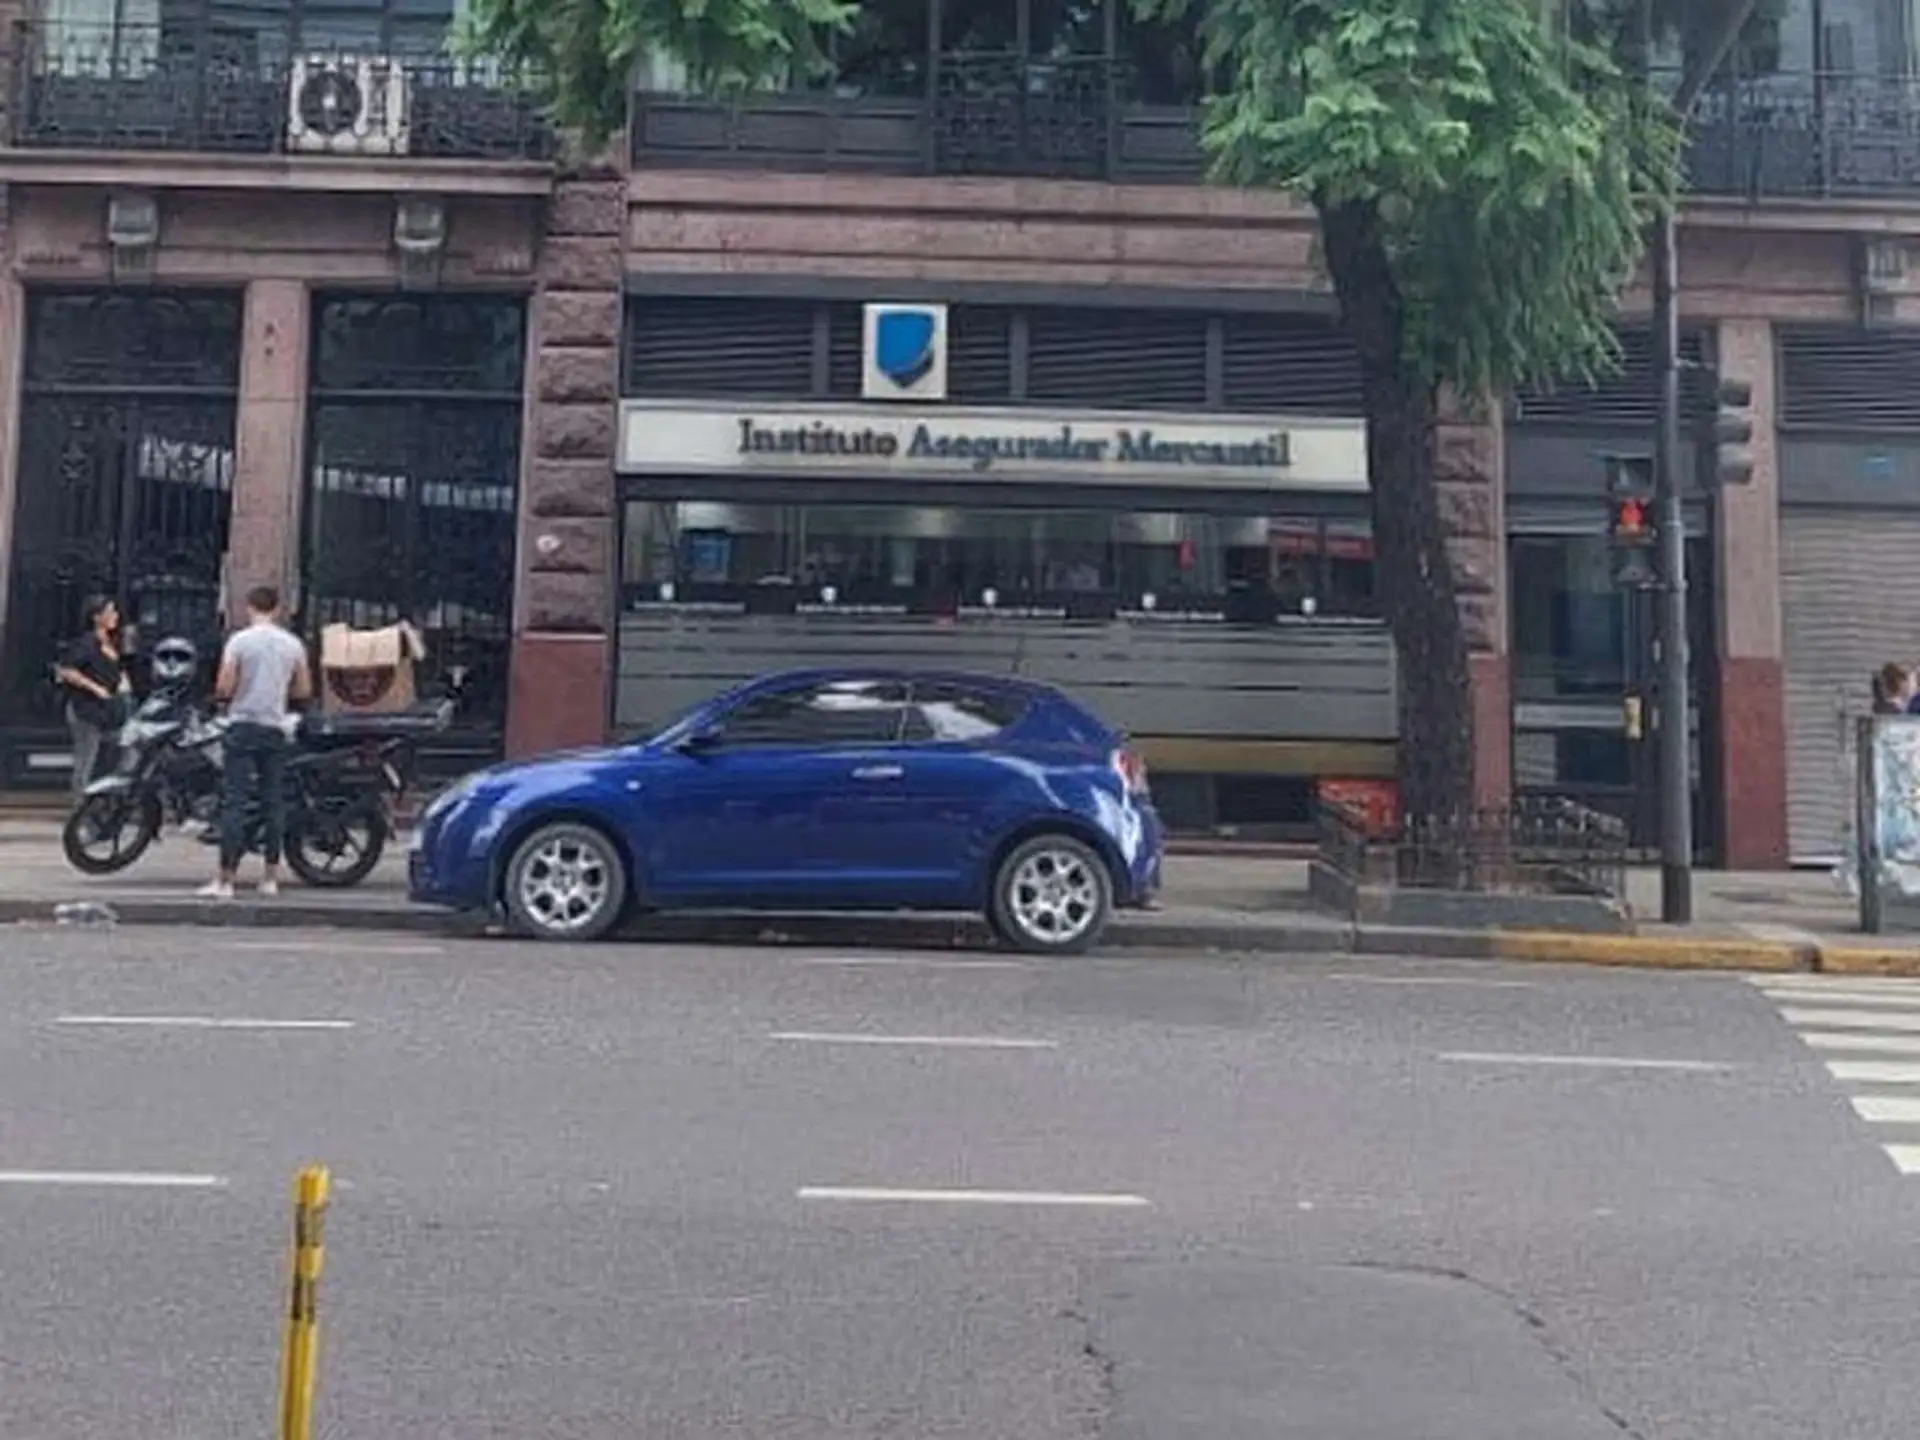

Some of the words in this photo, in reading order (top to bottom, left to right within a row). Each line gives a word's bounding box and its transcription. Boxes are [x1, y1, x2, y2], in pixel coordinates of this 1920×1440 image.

[738, 418, 898, 456] Instituto
[906, 423, 1109, 472] Asegurador
[1116, 427, 1291, 467] Mercantil
